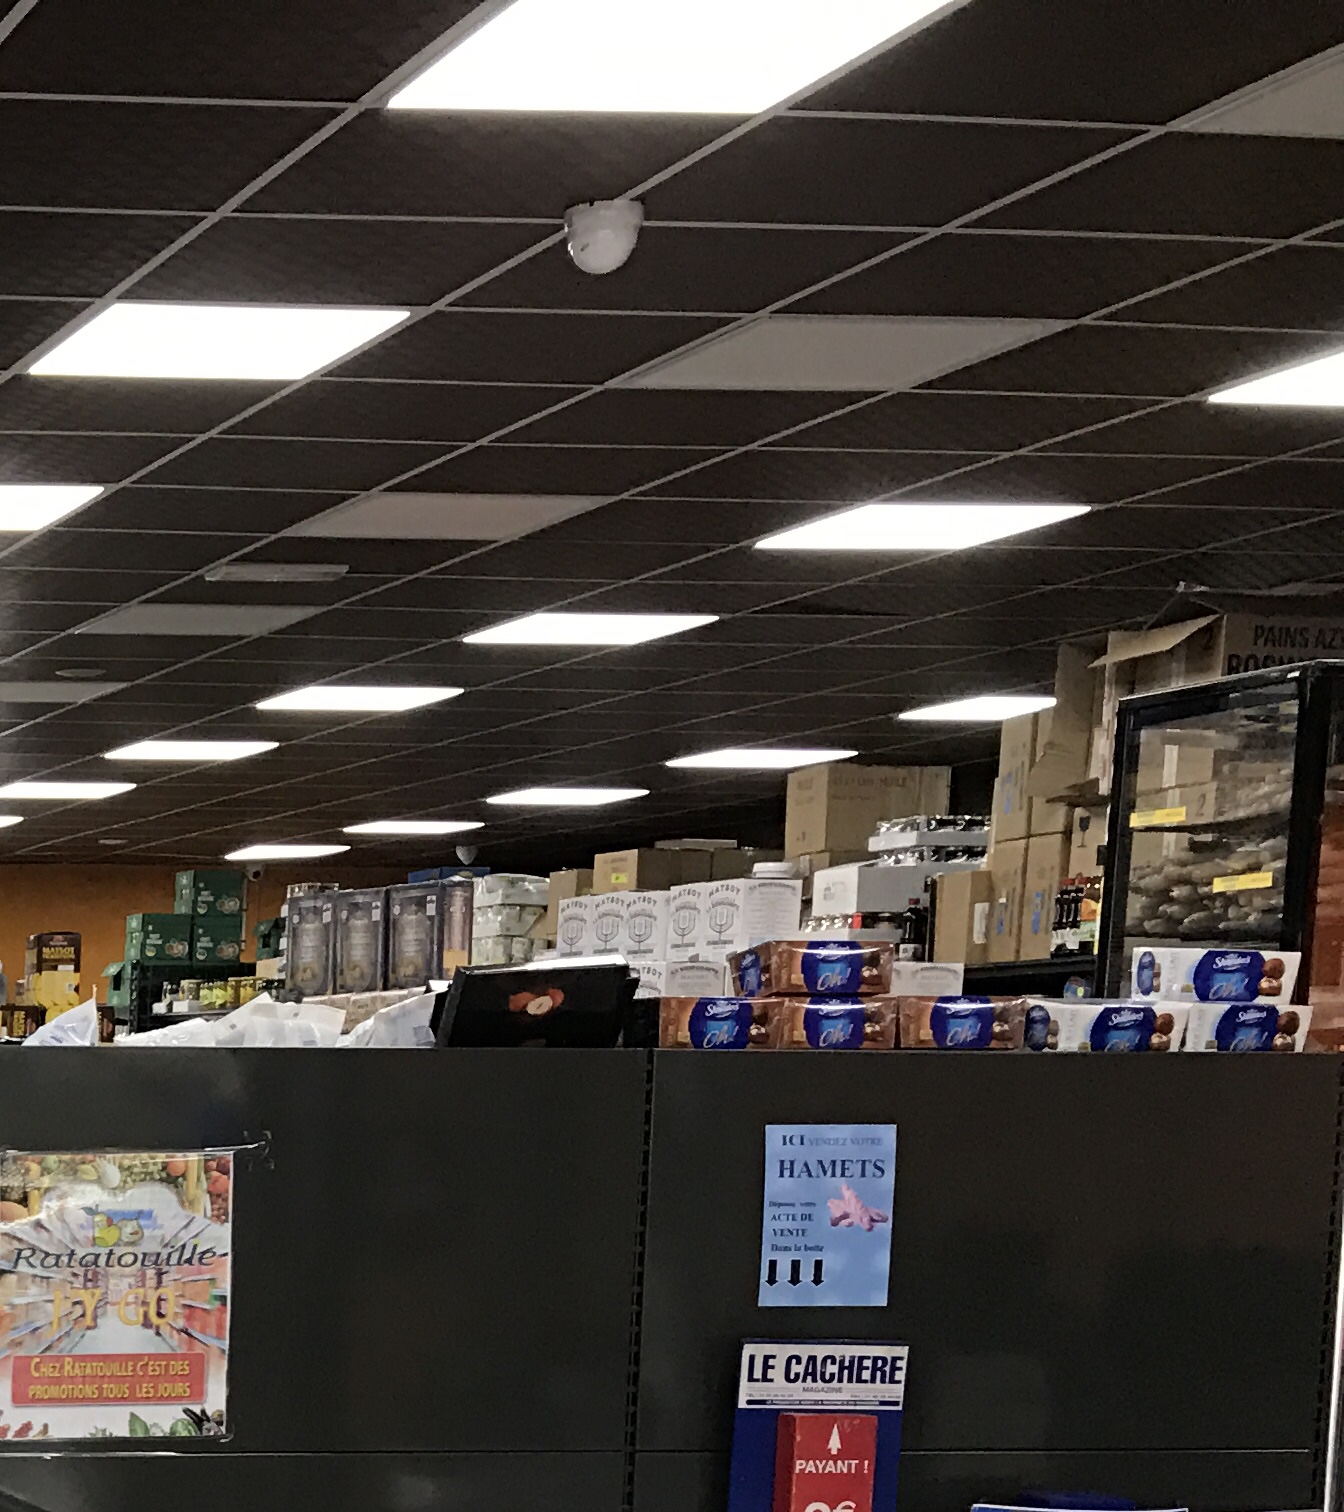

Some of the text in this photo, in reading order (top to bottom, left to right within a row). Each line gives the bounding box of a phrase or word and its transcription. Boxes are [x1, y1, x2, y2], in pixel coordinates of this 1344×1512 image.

[1254, 625, 1310, 648] PAINS
[782, 1135, 805, 1146] ICI
[778, 1159, 885, 1178] HAMETS
[771, 1213, 814, 1222] ACTE DE
[773, 1228, 808, 1237] VENTE
[13, 1243, 216, 1269] Ratatouille
[118, 1287, 175, 1325] GO
[747, 1354, 905, 1384] LE CACHERE
[795, 1460, 859, 1474] PAYANT
